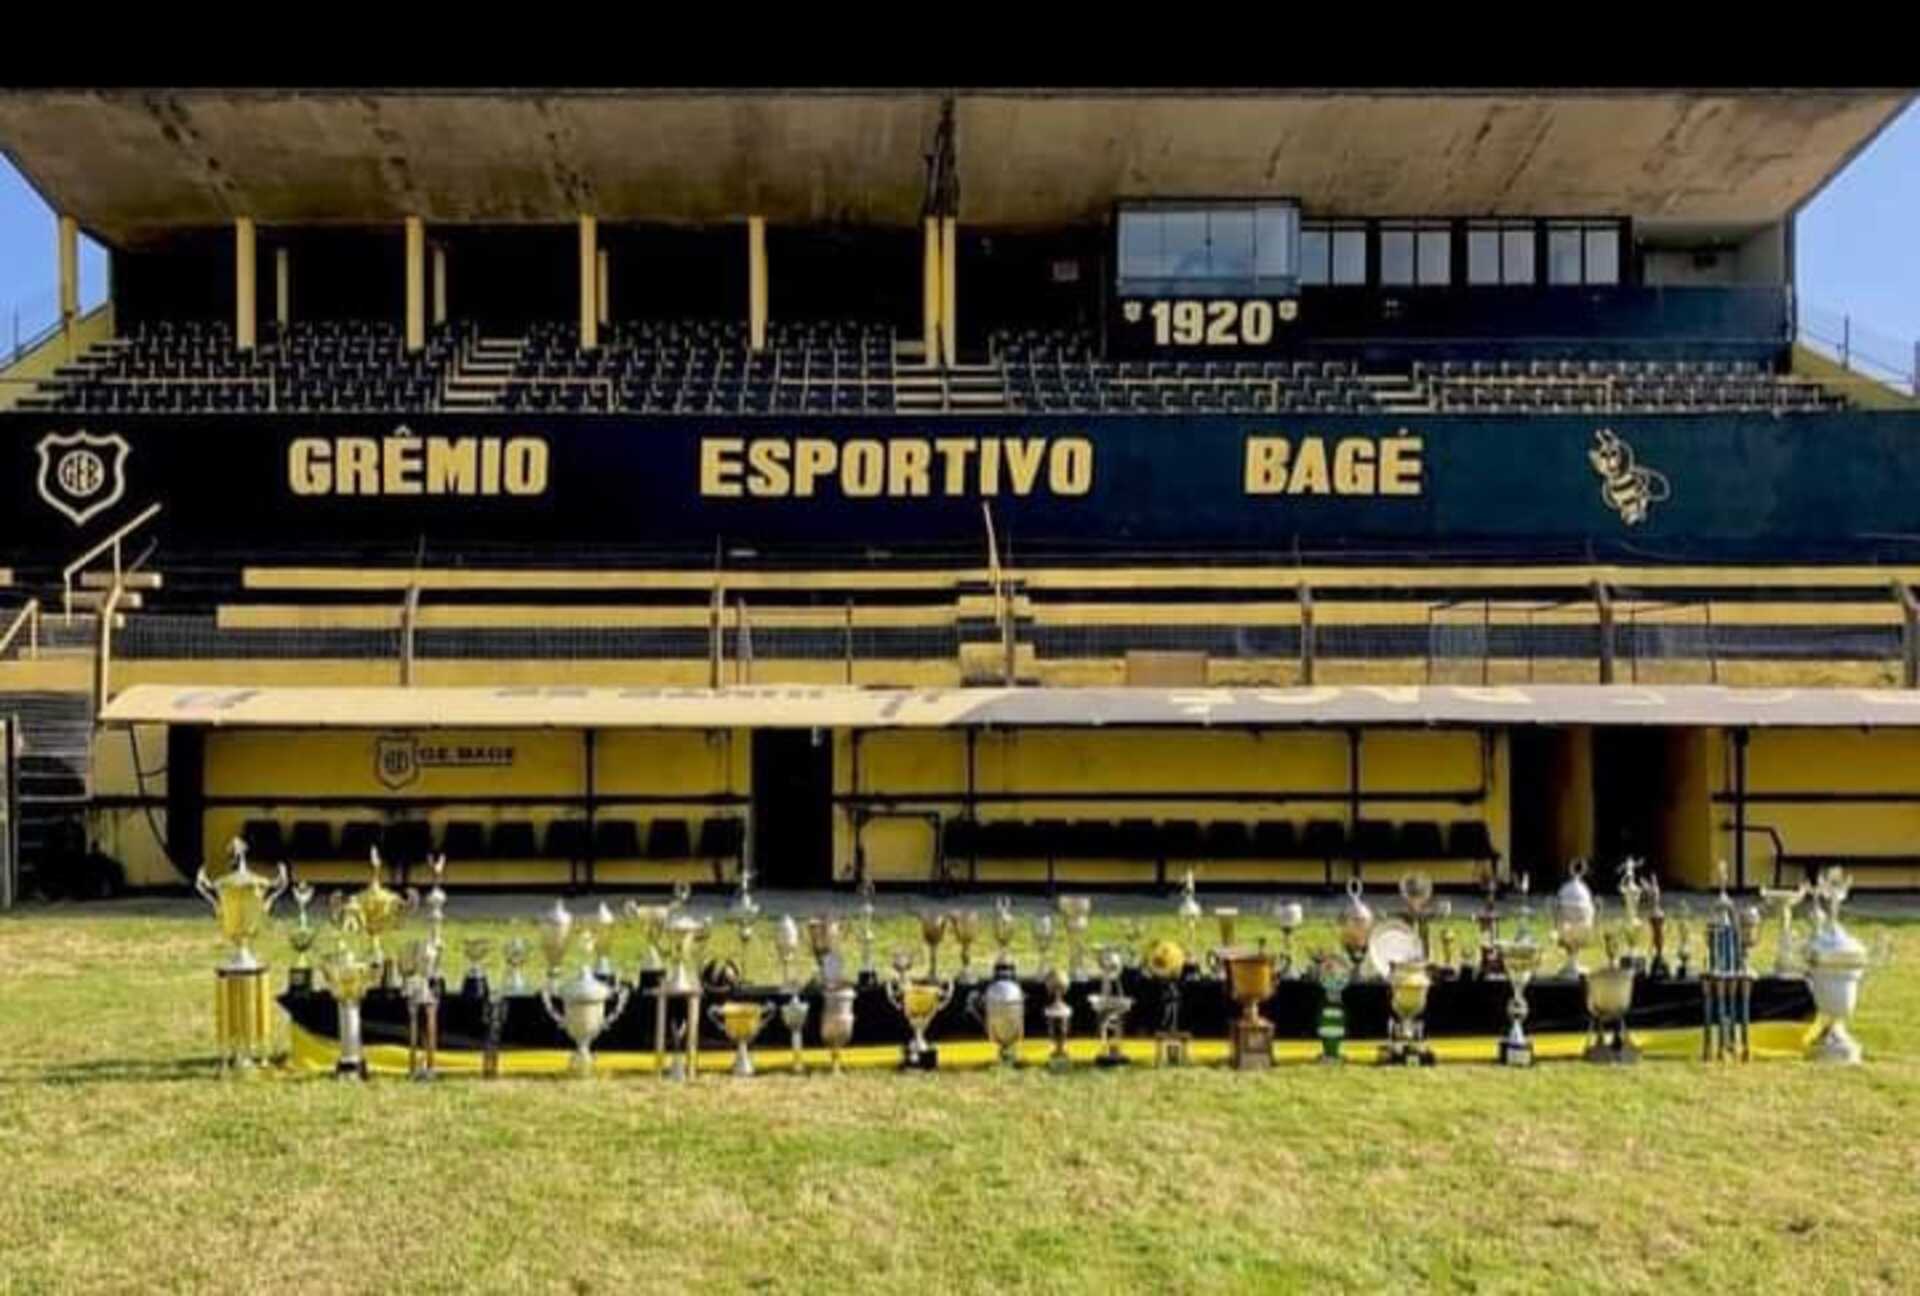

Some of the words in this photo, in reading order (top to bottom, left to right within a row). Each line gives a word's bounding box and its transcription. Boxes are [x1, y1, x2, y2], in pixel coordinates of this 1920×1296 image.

[1151, 301, 1273, 345] 1920
[288, 425, 549, 495] GRÊMIO
[700, 437, 1094, 497] ESPORTIVO
[1244, 428, 1424, 495] BAGÉ
